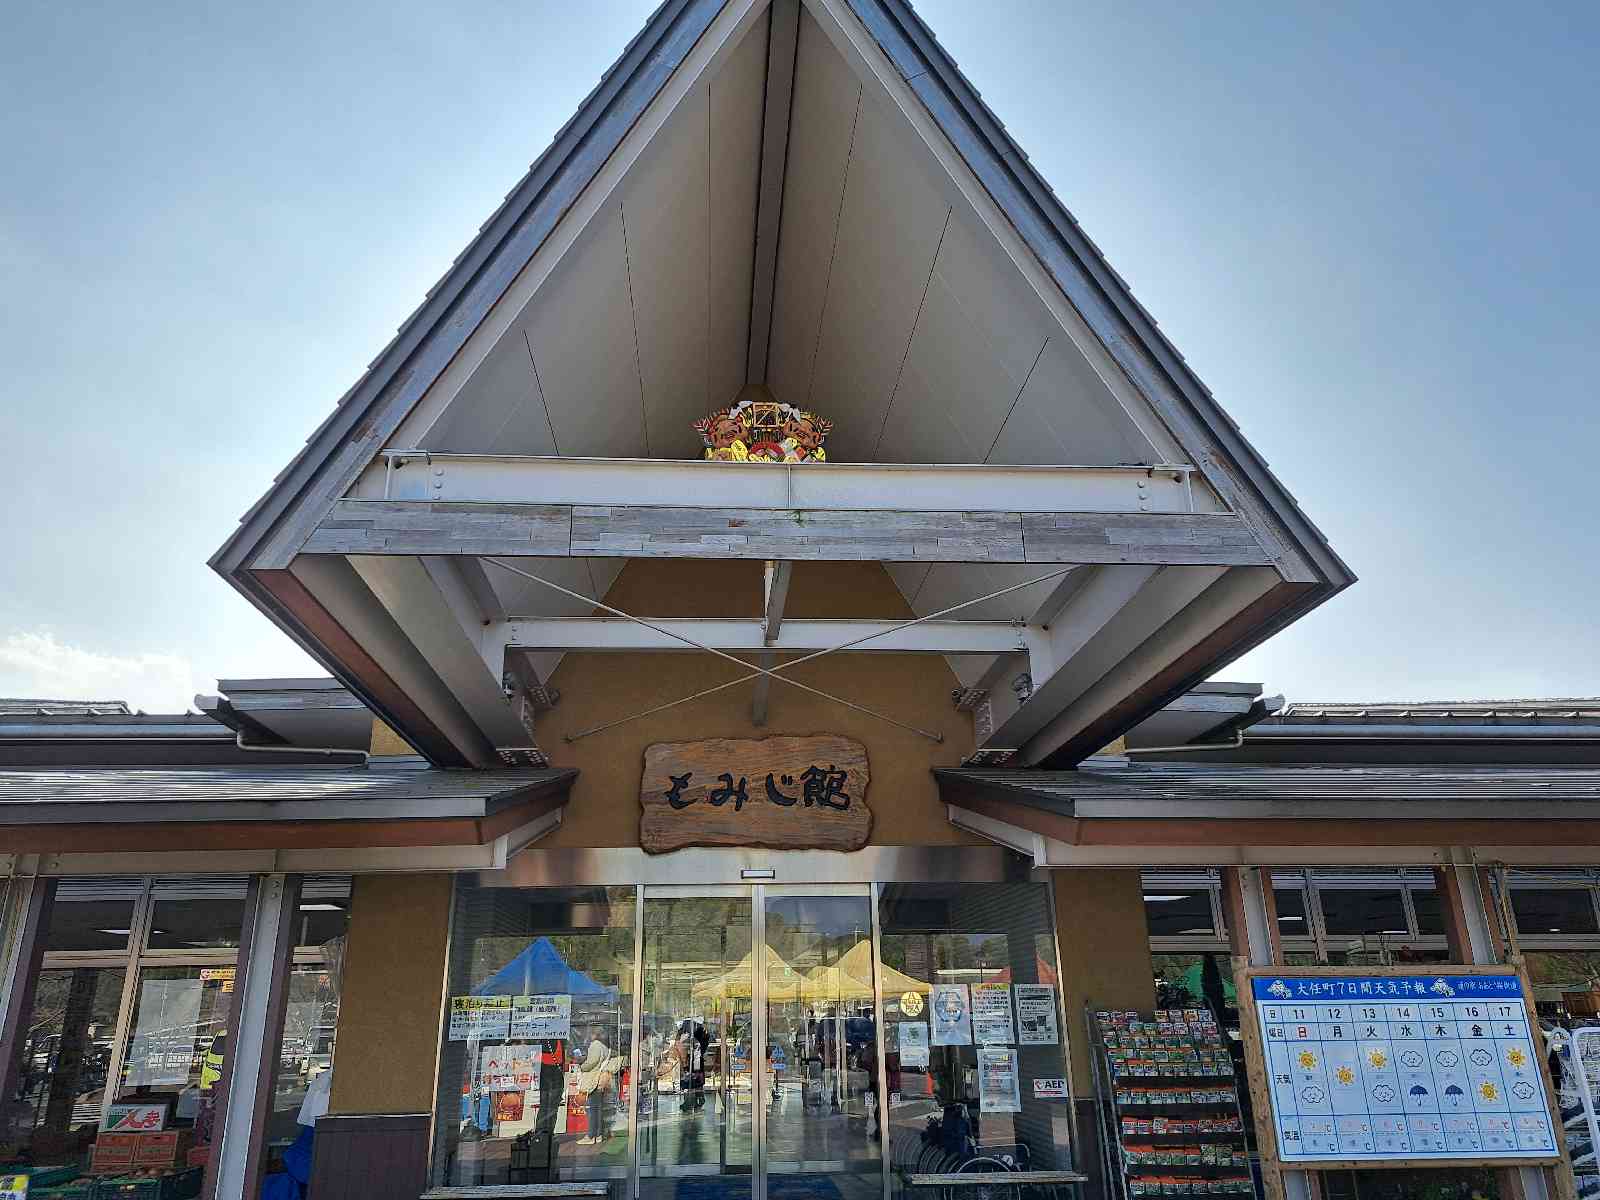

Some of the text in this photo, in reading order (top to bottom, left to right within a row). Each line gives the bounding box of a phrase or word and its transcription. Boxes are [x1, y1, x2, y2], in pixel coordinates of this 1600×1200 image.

[1297, 981, 1427, 996] 大任町7日間天気予報
[1294, 1009, 1305, 1019] 11
[1328, 1008, 1341, 1019] 12
[1362, 1008, 1376, 1019] 13
[1397, 1008, 1410, 1018] 14
[1431, 1007, 1444, 1018] 15
[1465, 1006, 1479, 1017] 16
[1499, 1006, 1511, 1017] 17
[1298, 1027, 1307, 1038] 日
[1333, 1026, 1342, 1037] 月
[1367, 1026, 1378, 1037] 火
[1401, 1024, 1413, 1036] 水
[1435, 1024, 1447, 1036] 木
[1472, 1024, 1483, 1037] 金
[1504, 1024, 1517, 1035] 土
[1045, 1080, 1065, 1089] AED
